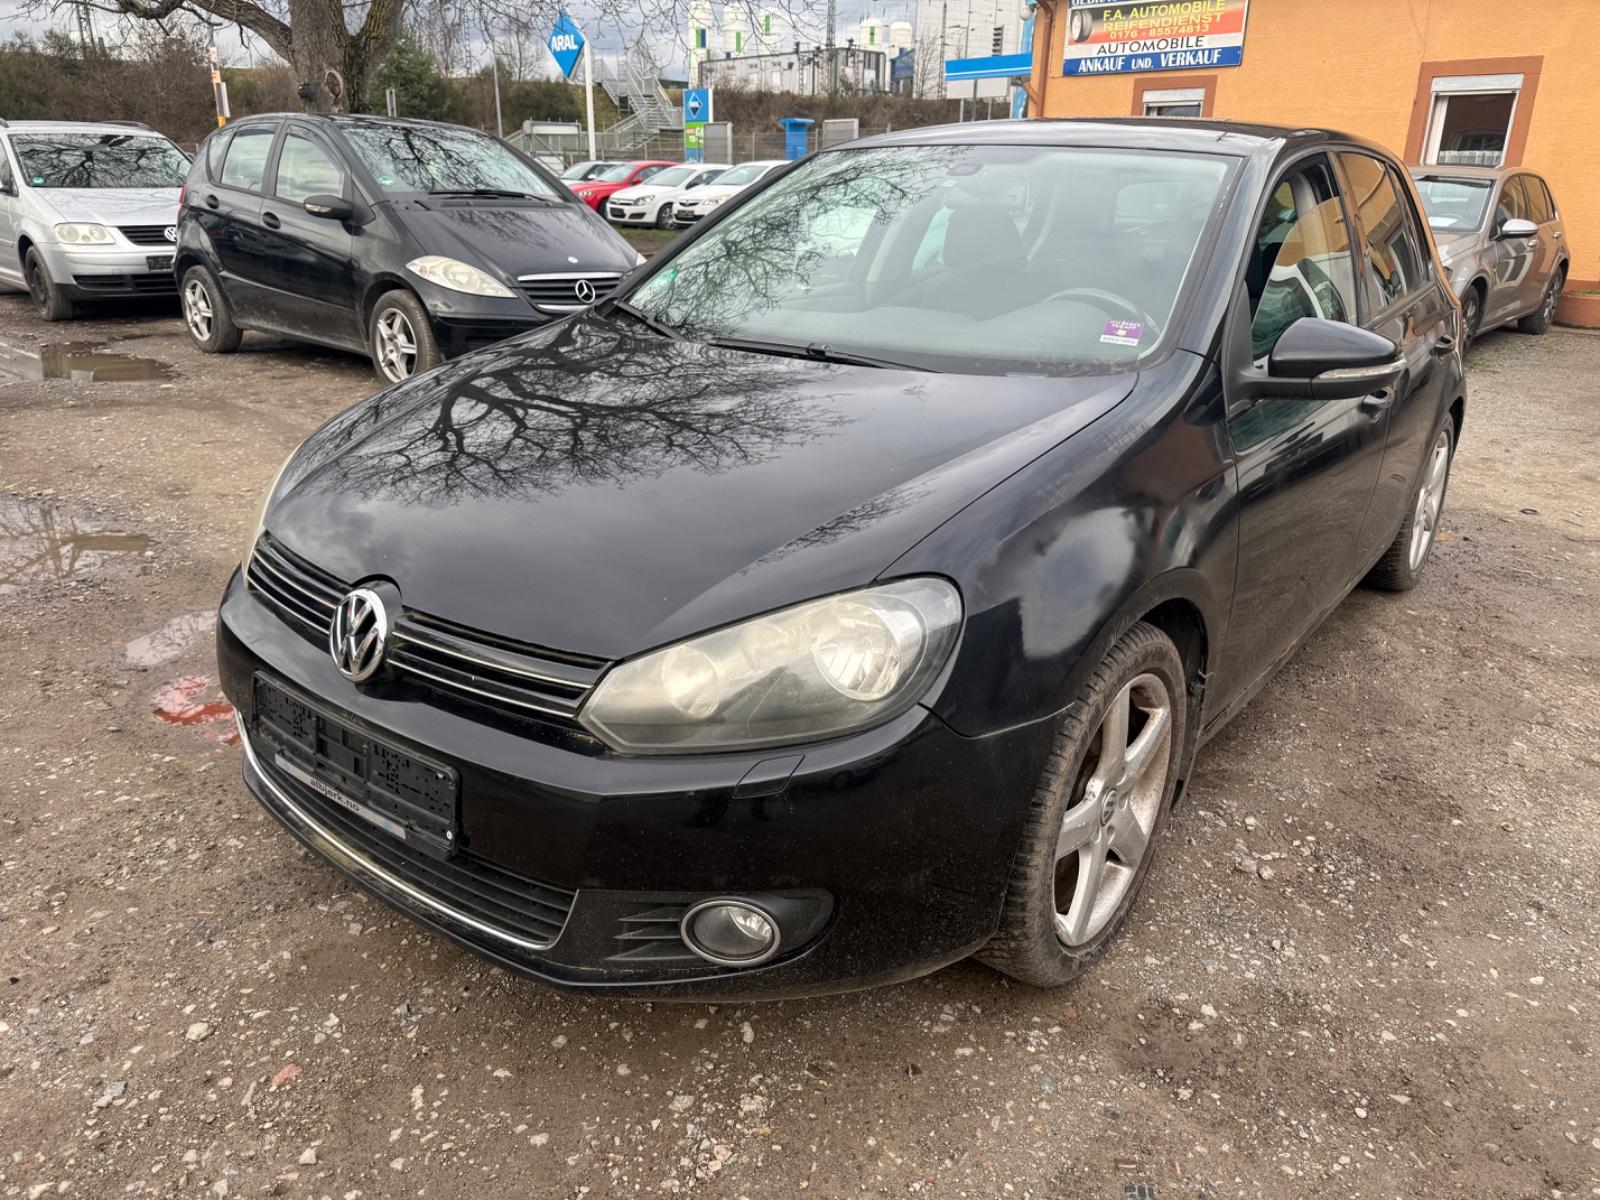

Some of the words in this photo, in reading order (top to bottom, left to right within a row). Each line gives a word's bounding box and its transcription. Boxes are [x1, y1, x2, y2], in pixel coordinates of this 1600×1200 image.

[1103, 9, 1126, 21] F.A.
[1129, 0, 1226, 19] AUTOMOBILE
[1103, 12, 1224, 31] REIFENDIENST
[1110, 30, 1138, 39] 0176
[1149, 24, 1210, 37] 85574813
[551, 34, 578, 52] ARAL
[1097, 36, 1205, 55] AUTOMOBILE
[1078, 57, 1126, 73] ANKAUF
[1160, 49, 1222, 68] VERKAUF
